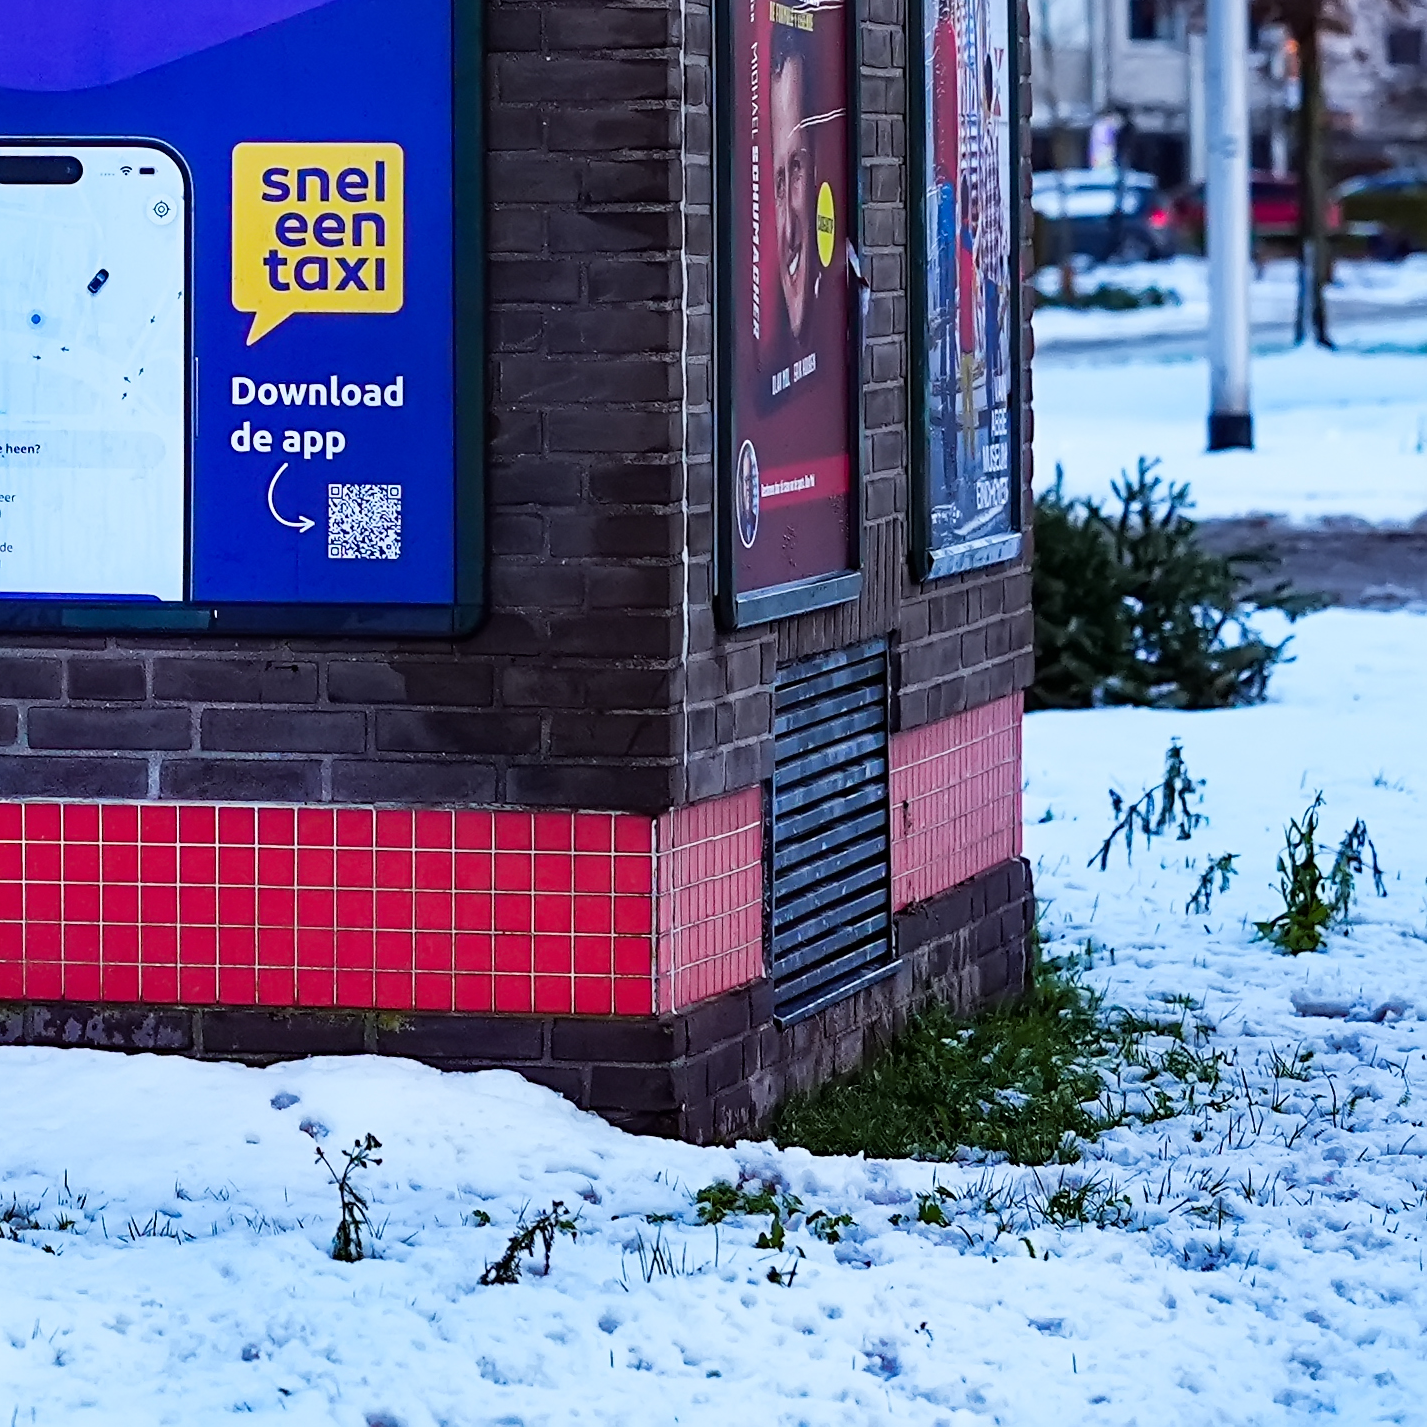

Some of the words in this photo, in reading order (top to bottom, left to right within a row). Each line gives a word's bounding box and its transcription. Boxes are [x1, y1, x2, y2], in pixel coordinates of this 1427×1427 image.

[750, 42, 759, 140] MICHAEL
[261, 160, 386, 203] snel
[275, 211, 386, 248] een
[751, 145, 760, 341] SCHUMACHER
[263, 249, 385, 292] taxi
[231, 375, 404, 408] Download
[6, 443, 41, 454] heen?
[231, 421, 273, 453] de
[283, 429, 346, 460] app
[982, 442, 1008, 474] MUSEUM
